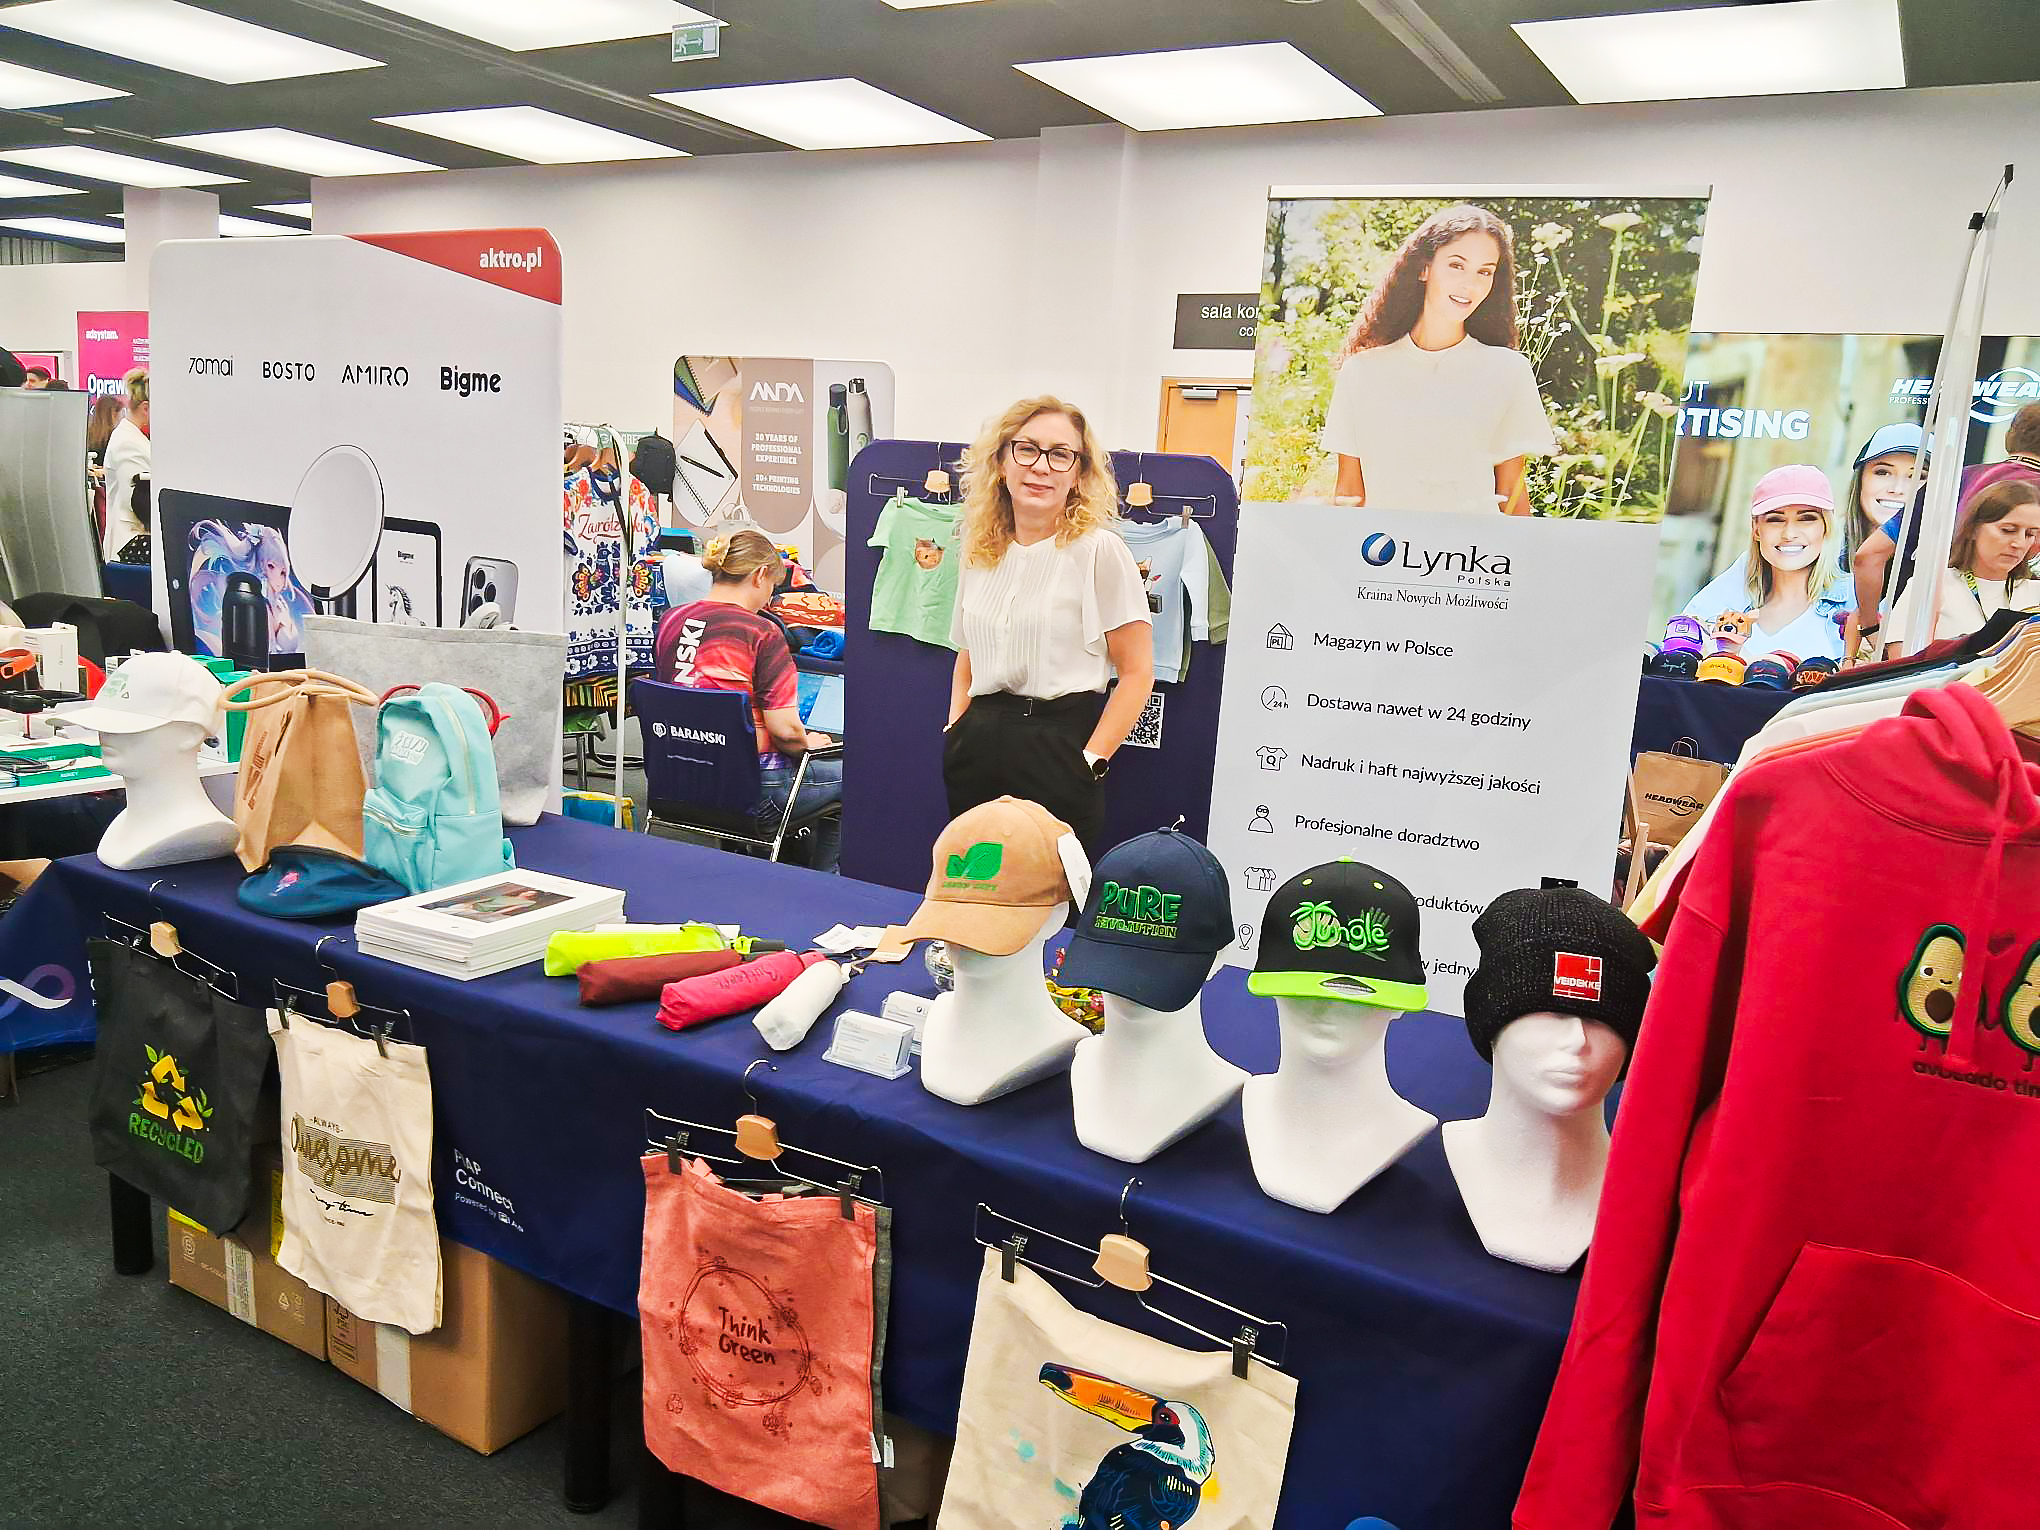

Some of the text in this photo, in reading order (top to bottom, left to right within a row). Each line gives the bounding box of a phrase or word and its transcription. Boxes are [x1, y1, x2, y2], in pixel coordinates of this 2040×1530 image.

[479, 247, 543, 272] aktro.pl
[1201, 303, 1233, 319] sala
[188, 355, 234, 376] 70mai
[262, 361, 316, 382] BOSTO
[341, 364, 410, 388] AMIRO
[87, 373, 129, 399] Opraw
[440, 366, 502, 397] Bigme
[749, 381, 805, 403] ANDA
[1889, 396, 1930, 405] PROFESS
[751, 443, 802, 455] PROFESSIONAL
[789, 434, 799, 443] OF
[755, 454, 798, 465] EXPERIENCE
[752, 484, 801, 495] TECHNOLOGIES
[1402, 541, 1512, 577] Lynka
[1457, 575, 1511, 587] Polska
[1357, 586, 1509, 610] Kraina Nowych Możliwości
[674, 617, 707, 685] NSKI
[1313, 632, 1454, 657] Magazyn w Polsce
[1273, 701, 1282, 709] 24
[1307, 693, 1532, 732] Dostawa nawet w 24 godziny
[1266, 755, 1277, 766] Q
[1301, 753, 1541, 795] Nadruk i haft najwyższej jakości
[1644, 792, 1705, 811] HEADWEAR
[1295, 814, 1480, 851] Profesjonalne doradztwo
[1095, 915, 1178, 939] REVOLUTION
[1292, 900, 1391, 952] Jungle
[1432, 958, 1479, 979] jedny
[1554, 976, 1602, 991] VEIDEKKE
[1912, 1060, 2009, 1091] avocado
[129, 1112, 204, 1164] RECYCLED
[456, 1168, 516, 1214] Connect
[718, 1306, 772, 1345] Think
[718, 1333, 776, 1365] Green
